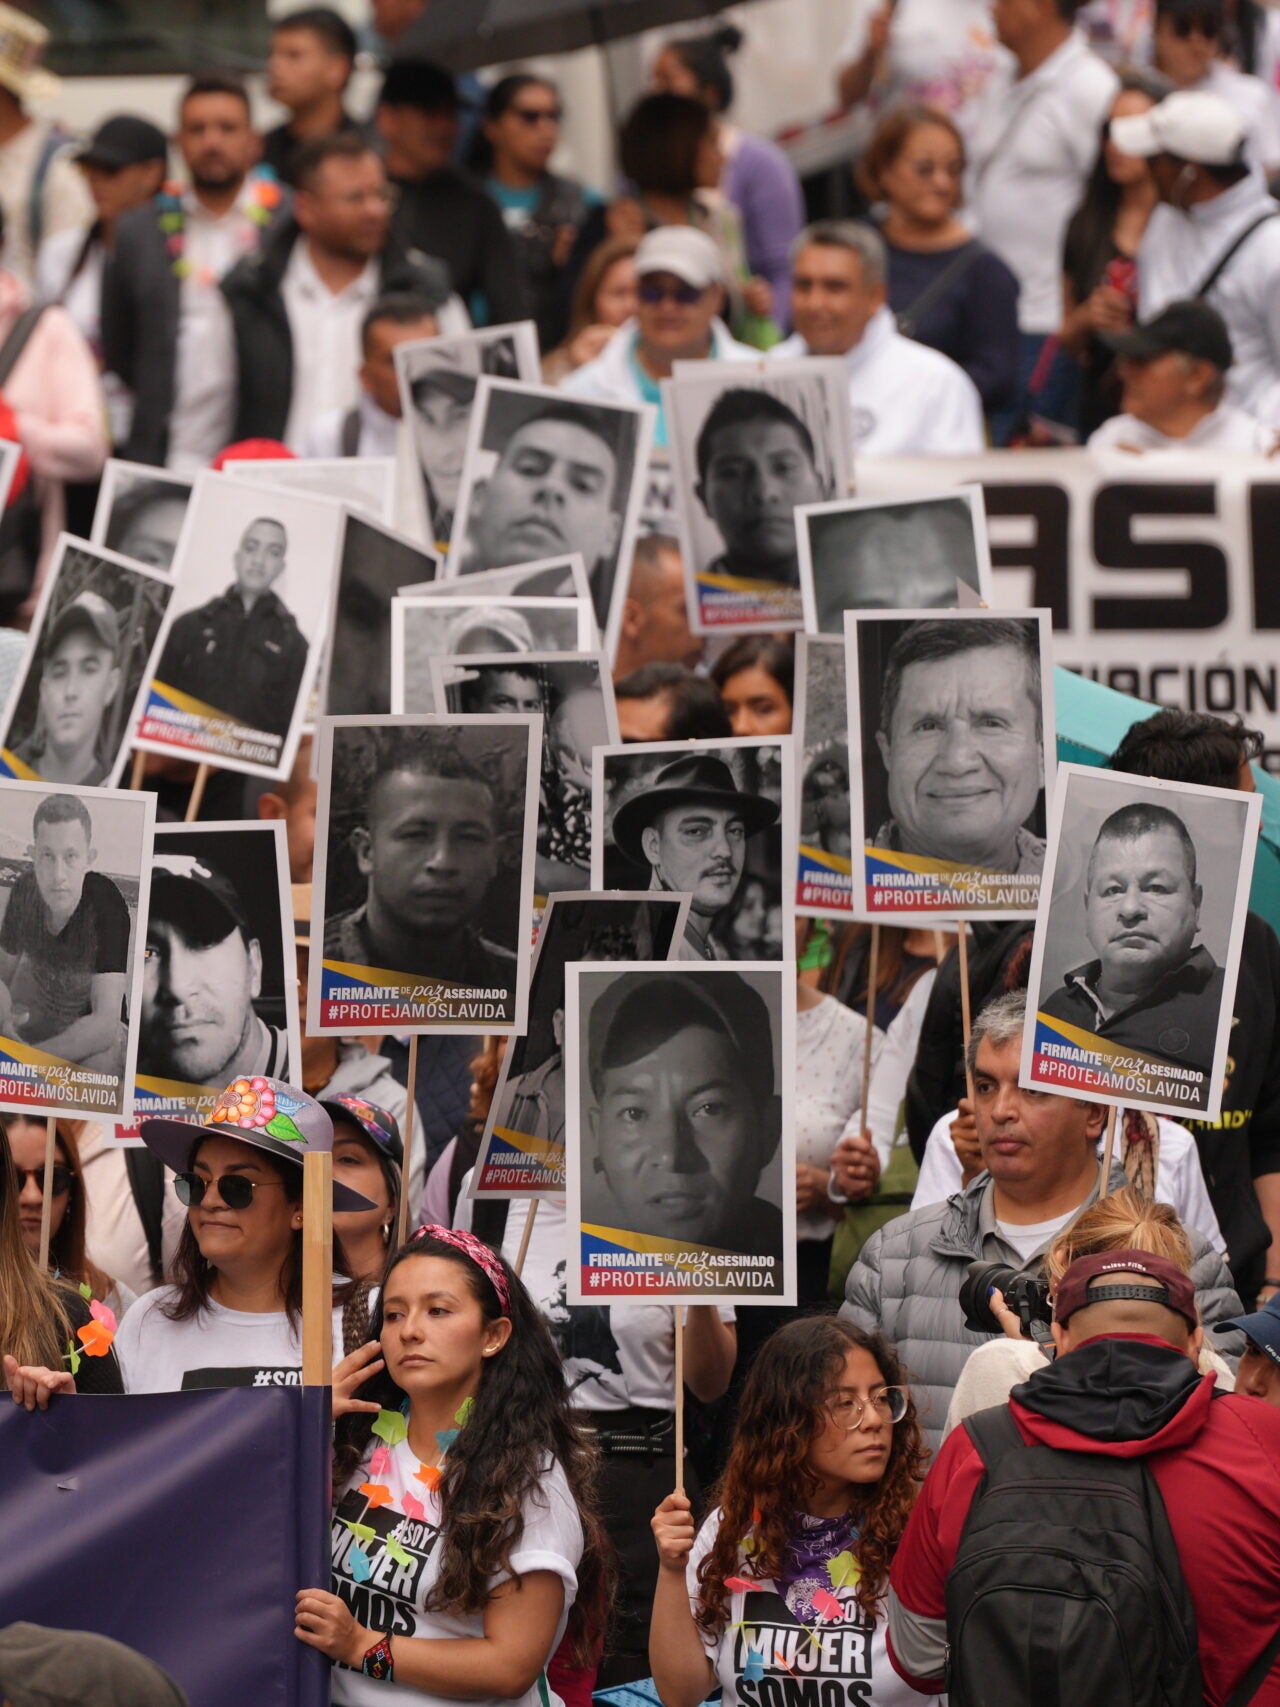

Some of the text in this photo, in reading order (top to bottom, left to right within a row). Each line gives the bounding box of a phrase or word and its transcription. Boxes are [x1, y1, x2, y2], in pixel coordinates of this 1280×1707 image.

[982, 481, 1280, 631] AS
[1070, 650, 1277, 714] ACIÓN
[872, 873, 940, 887] FIRMANTE
[948, 871, 982, 893] paz
[981, 874, 1040, 886] ASESINADO
[873, 888, 1040, 905] #PROTEJAMOSLAVIDA
[328, 984, 508, 1004] FIRMANTE DE paz ASESINADO
[328, 1003, 507, 1020] #PROTEJAMOSLAVIDA
[1040, 1041, 1204, 1084] FIRMANTE DE paz ASESINADO
[38, 1065, 47, 1075] DE
[45, 1064, 72, 1087] paz
[70, 1072, 120, 1088] ASESINADO
[1038, 1059, 1201, 1103] #PROTEJAMOSLAVIDA
[195, 1094, 222, 1113] pa
[489, 1152, 538, 1165] FIRMANTE
[485, 1168, 566, 1184] #PROTEJAMOS
[589, 1251, 775, 1272] FIRMANTE DE paz ASESINADO
[589, 1271, 775, 1288] #PROTEJAMOSLAVIDA
[252, 1370, 302, 1387] #SO
[390, 1519, 437, 1550] #SOY
[739, 1628, 867, 1675] MUJER
